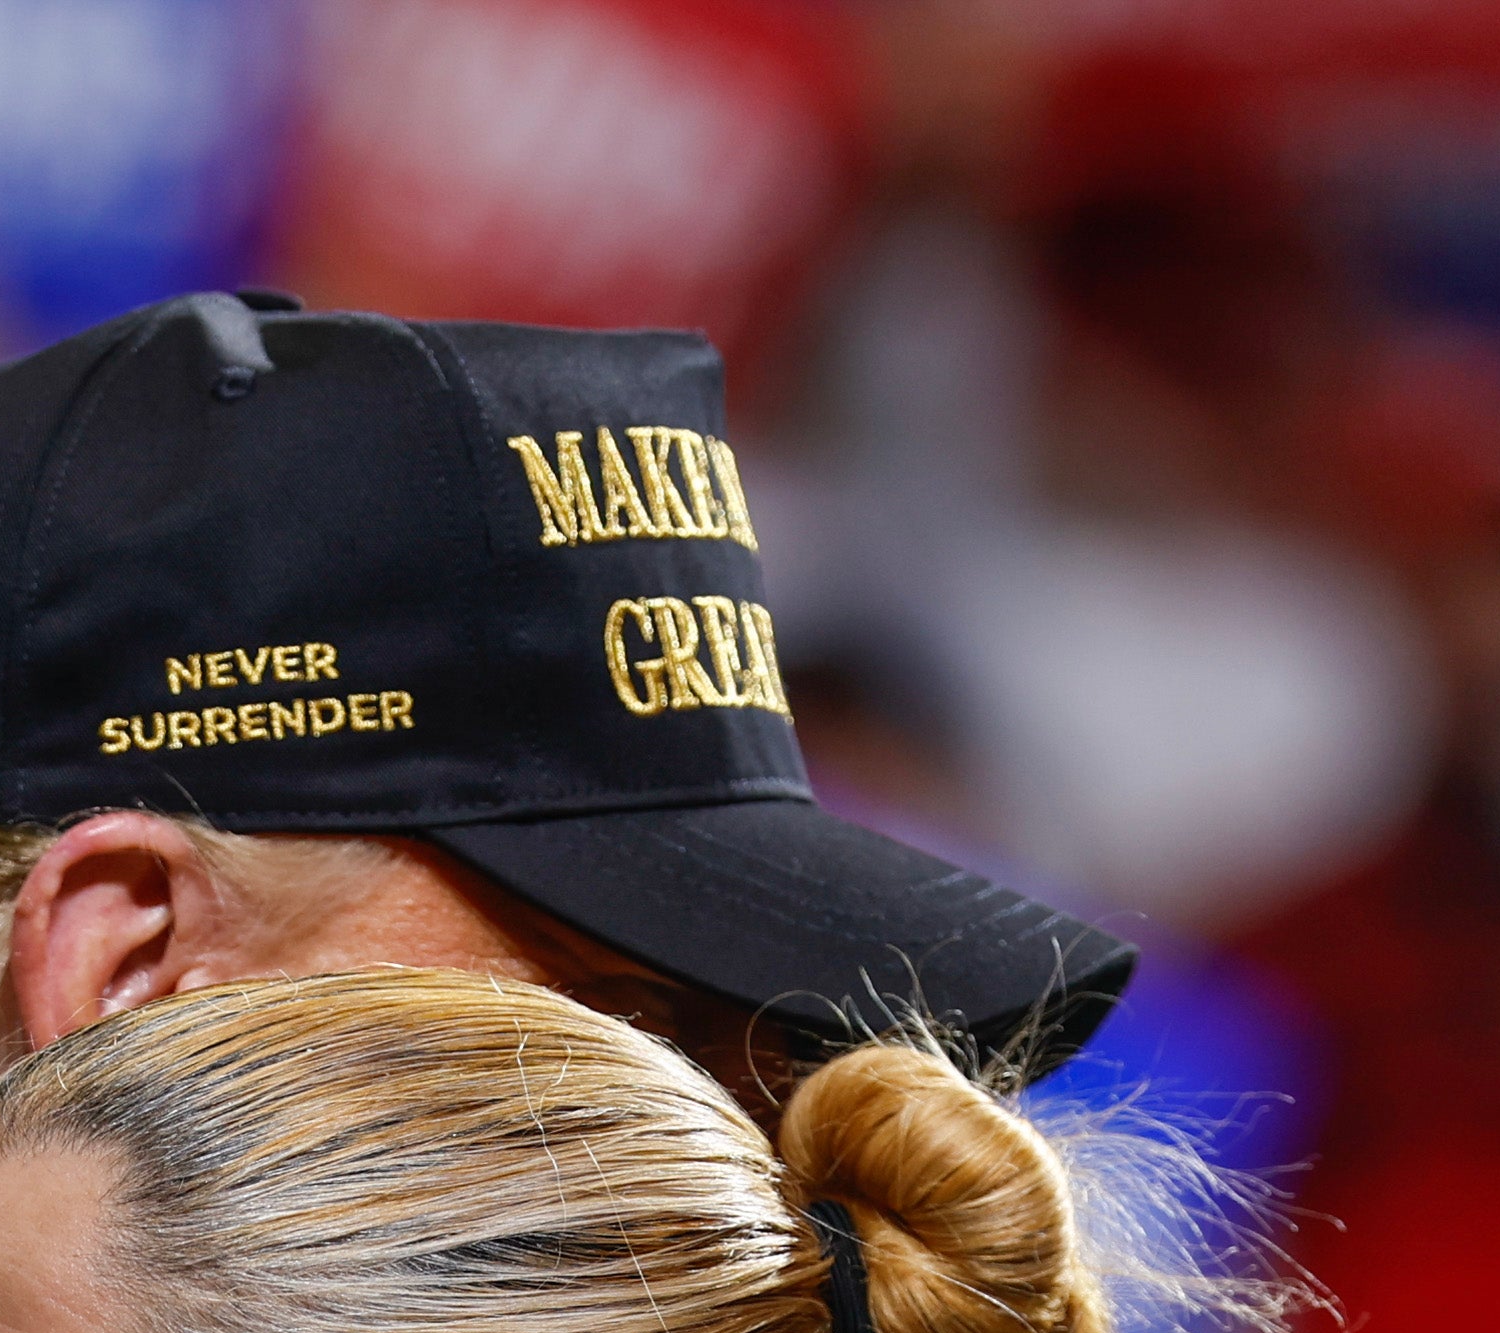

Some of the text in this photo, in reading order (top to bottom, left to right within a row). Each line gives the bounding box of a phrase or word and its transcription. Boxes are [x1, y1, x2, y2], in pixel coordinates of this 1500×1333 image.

[165, 642, 340, 695] NEVER
[604, 595, 795, 724] GREA
[97, 690, 416, 755] SURRENDER
